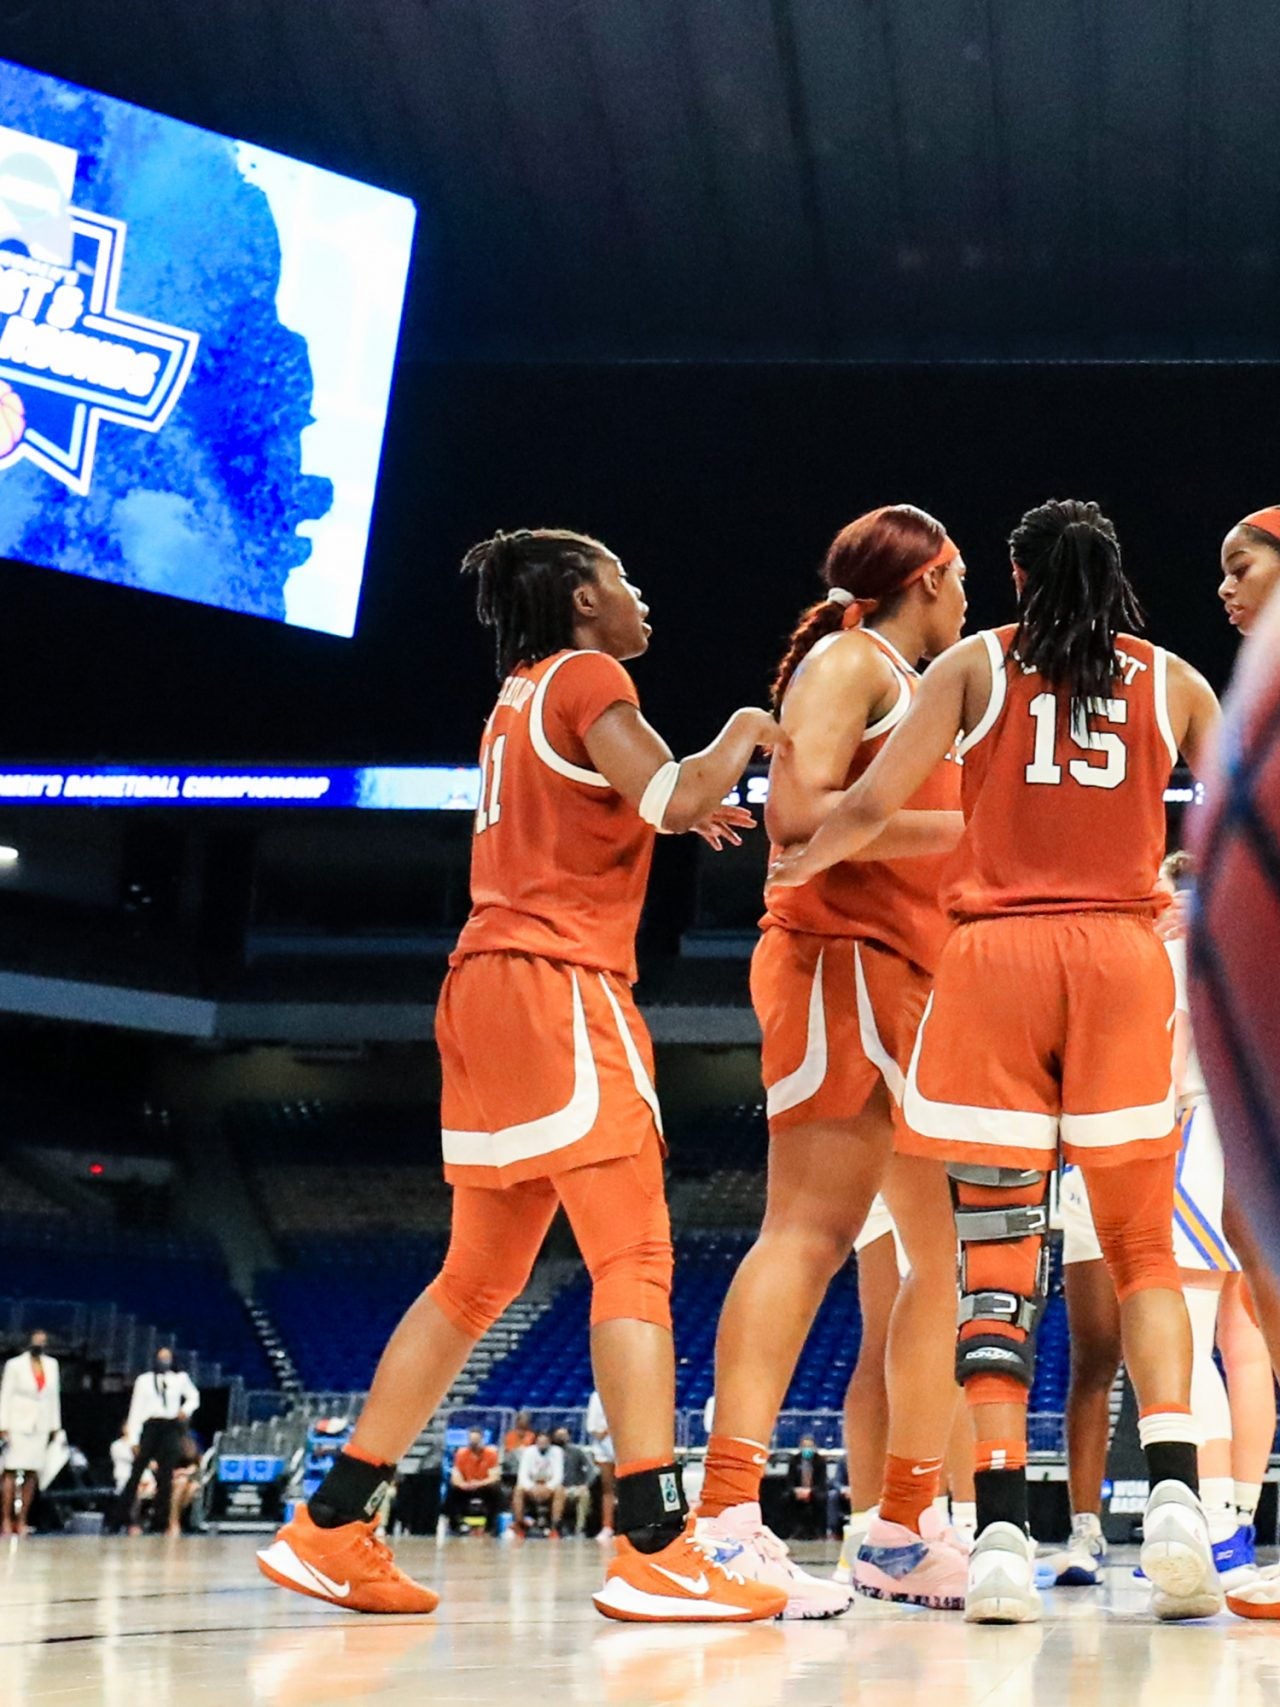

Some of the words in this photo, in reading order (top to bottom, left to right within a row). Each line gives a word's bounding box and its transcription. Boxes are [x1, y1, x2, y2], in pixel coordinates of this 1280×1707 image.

[0, 774, 63, 798] MEN'S
[63, 774, 179, 798] BASKETBALL
[181, 775, 330, 799] CHAMPIONSHIP
[475, 734, 508, 835] 11
[1024, 692, 1127, 789] 15
